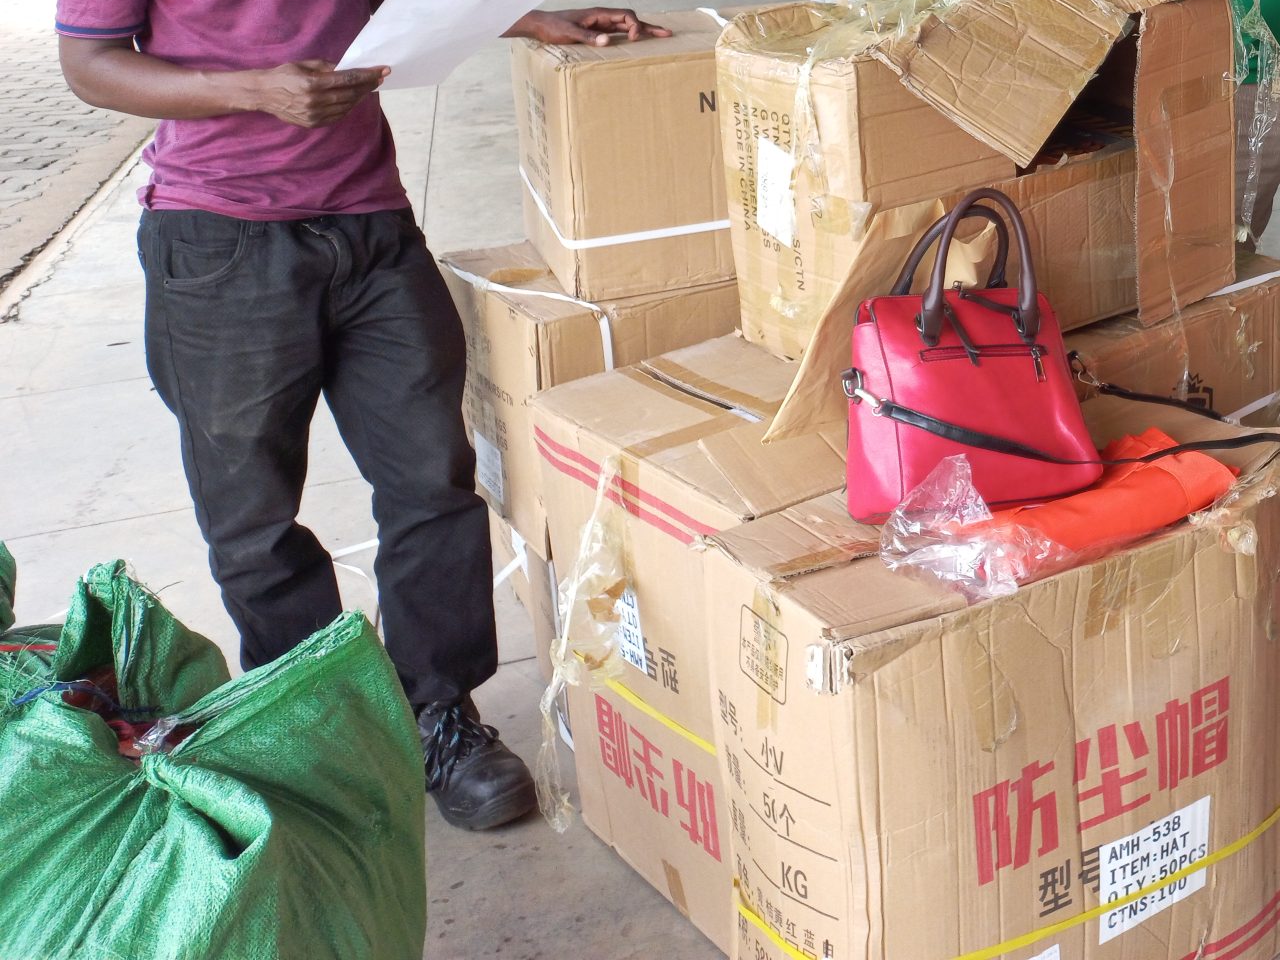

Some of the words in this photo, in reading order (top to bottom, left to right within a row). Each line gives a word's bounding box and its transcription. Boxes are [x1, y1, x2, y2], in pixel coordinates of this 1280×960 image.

[733, 102, 745, 151] MADE
[770, 111, 780, 147] CTN
[738, 156, 746, 172] IN
[740, 177, 752, 232] CHINA
[595, 693, 722, 863] 防尘帽
[972, 675, 1230, 887] 防尘帽
[1108, 815, 1181, 864] AMH-538
[781, 861, 809, 900] KG
[786, 918, 798, 939] 红
